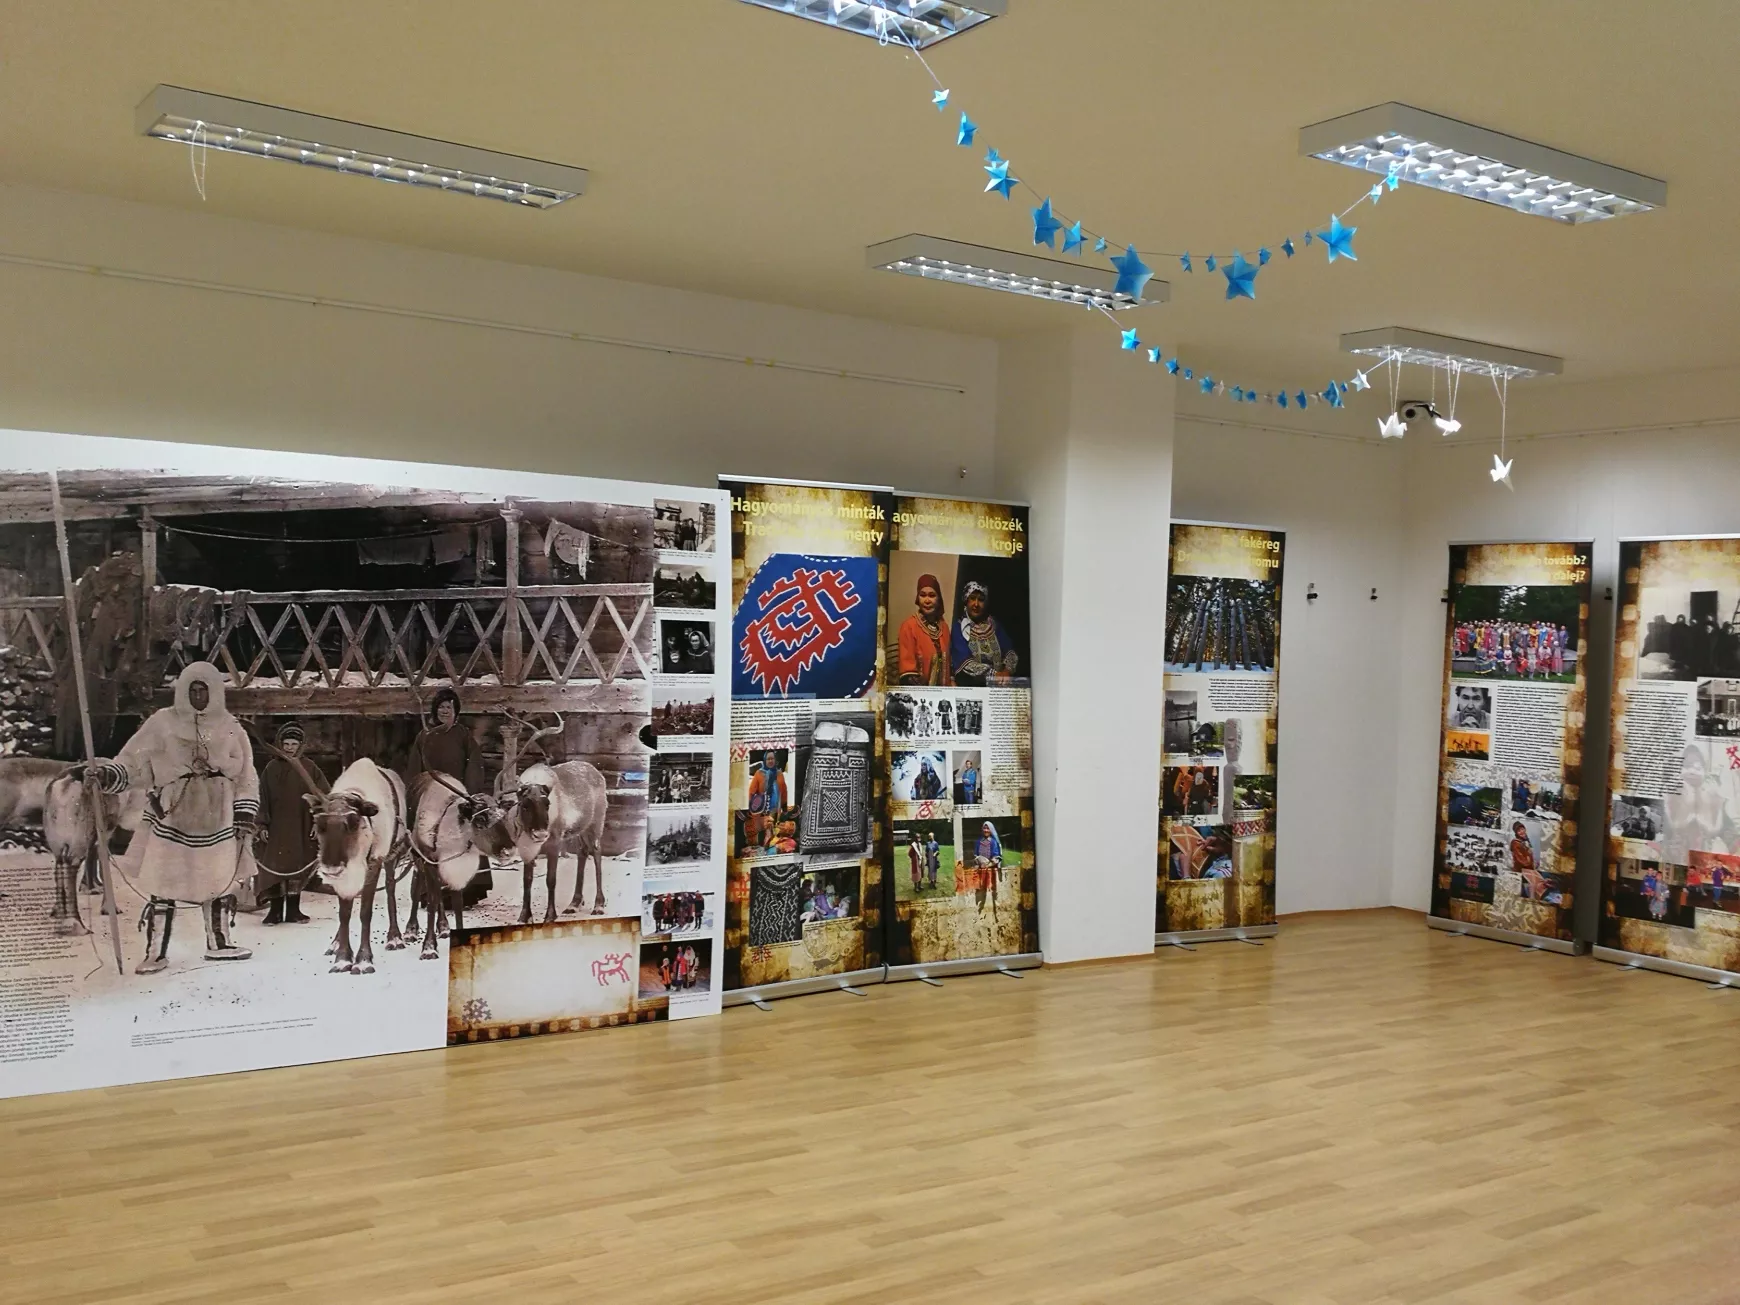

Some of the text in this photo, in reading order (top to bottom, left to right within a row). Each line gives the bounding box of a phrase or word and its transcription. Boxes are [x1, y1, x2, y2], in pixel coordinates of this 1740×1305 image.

[838, 503, 885, 521] minták
[977, 515, 1024, 532] öltözék
[1239, 535, 1280, 553] fakéreg
[1544, 555, 1587, 566] tovább?
